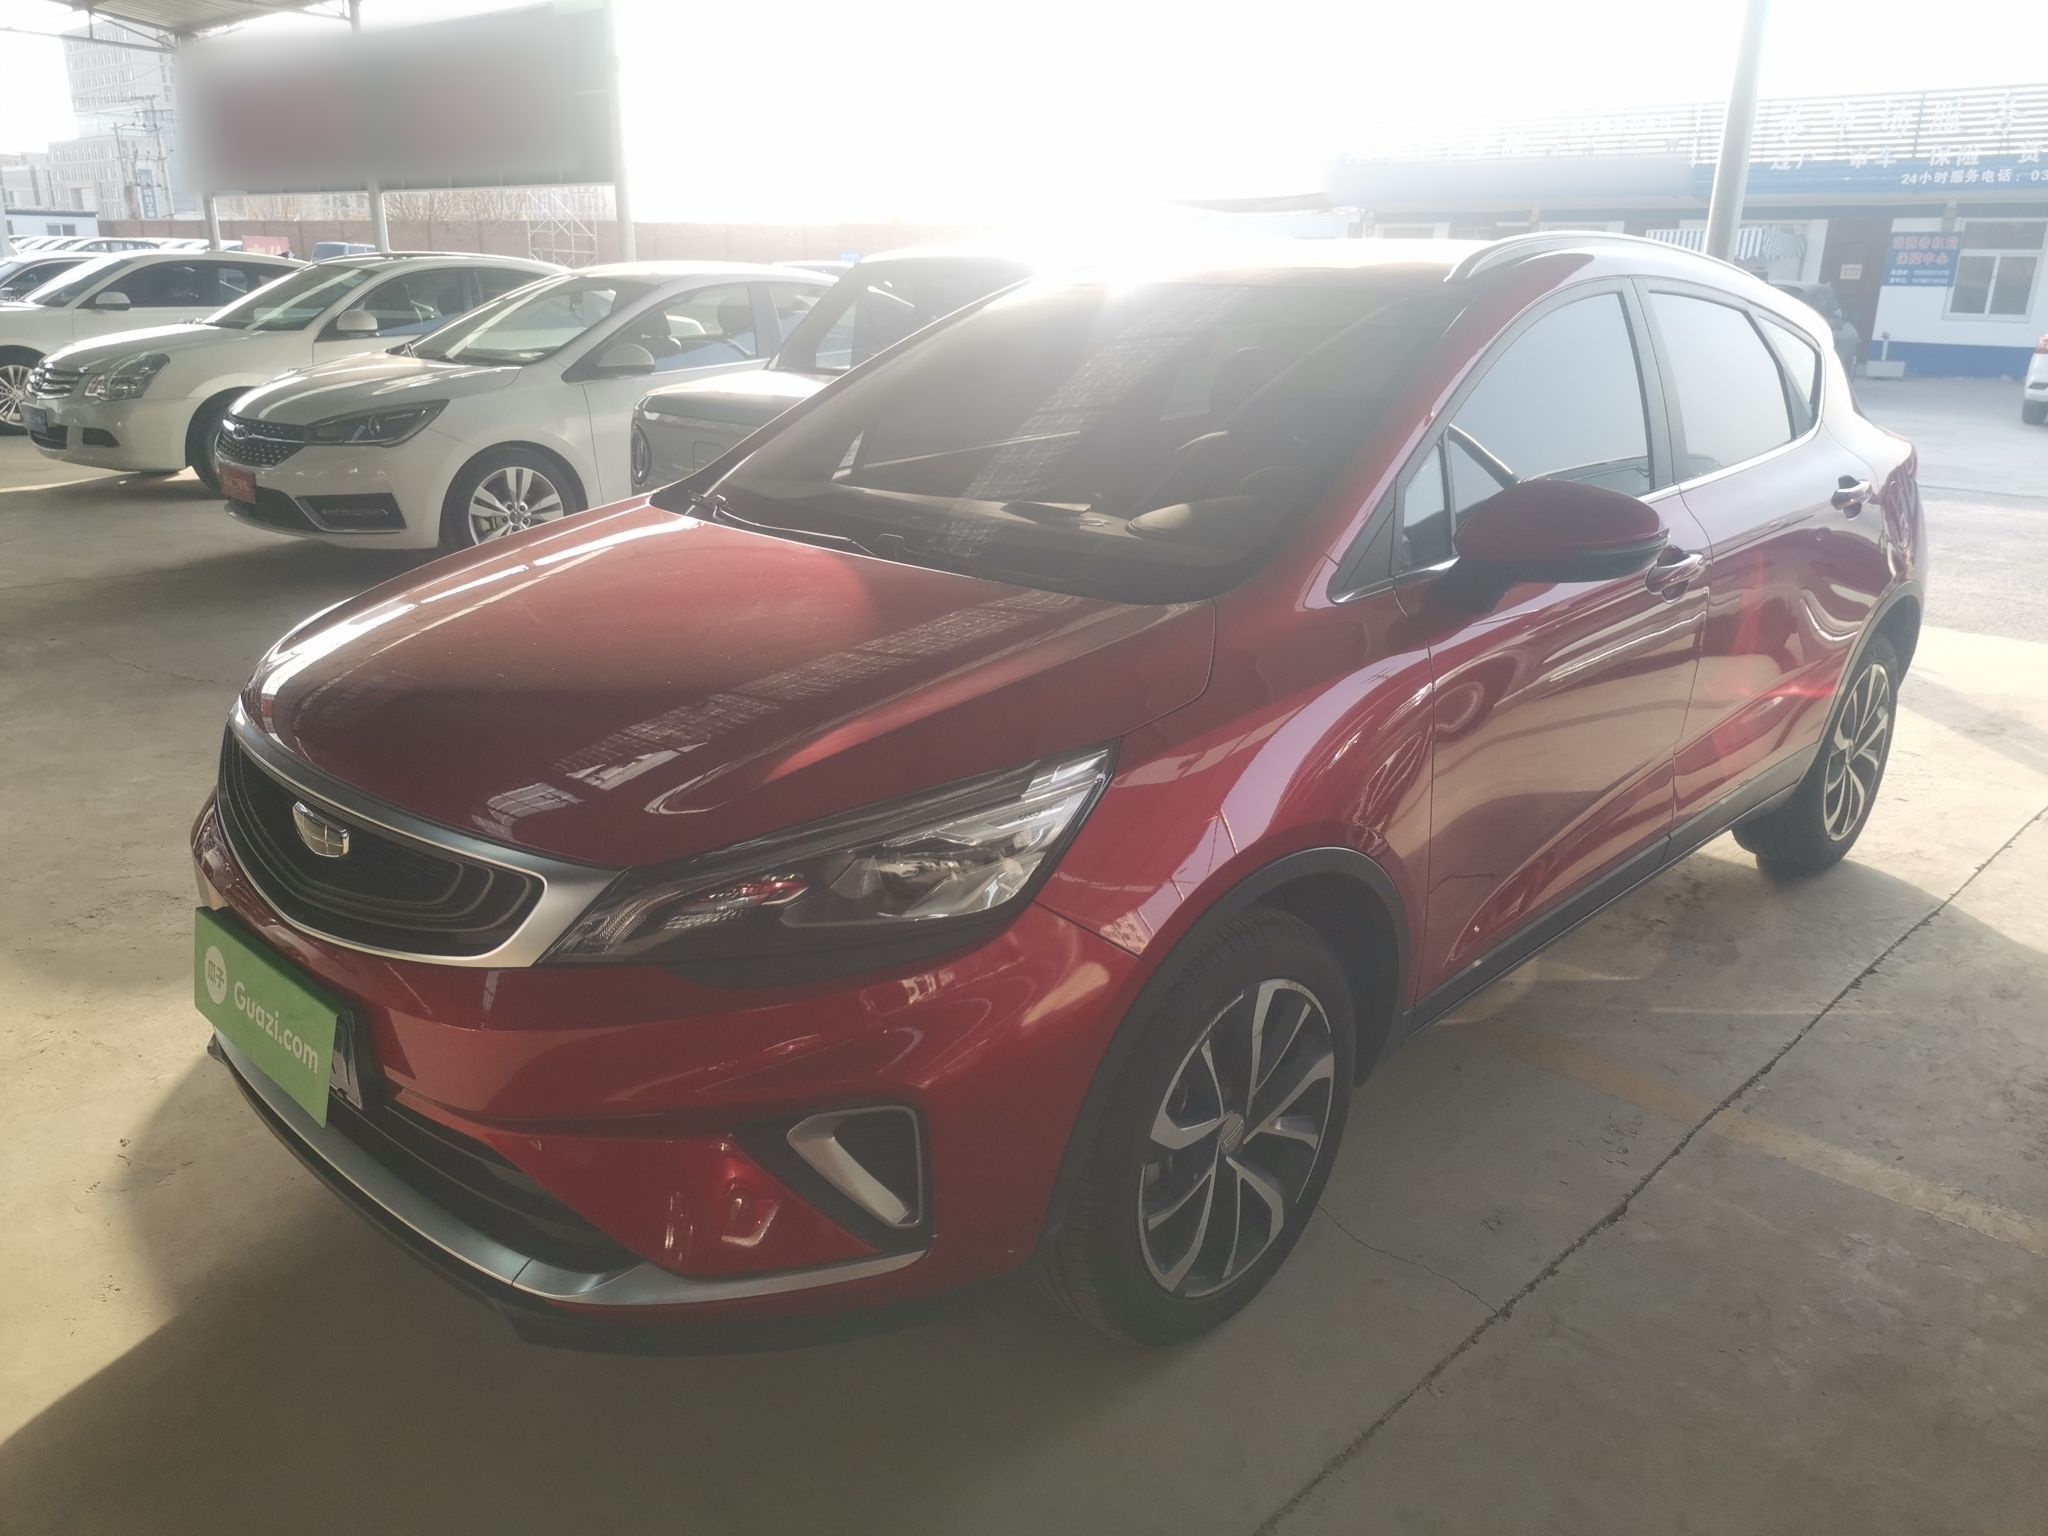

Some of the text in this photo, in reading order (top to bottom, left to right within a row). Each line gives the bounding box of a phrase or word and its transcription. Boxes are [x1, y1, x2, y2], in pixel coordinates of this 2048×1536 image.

[1929, 144, 1981, 166] 保险
[207, 960, 225, 989] 瓜子
[234, 981, 318, 1074] Guazi.com
